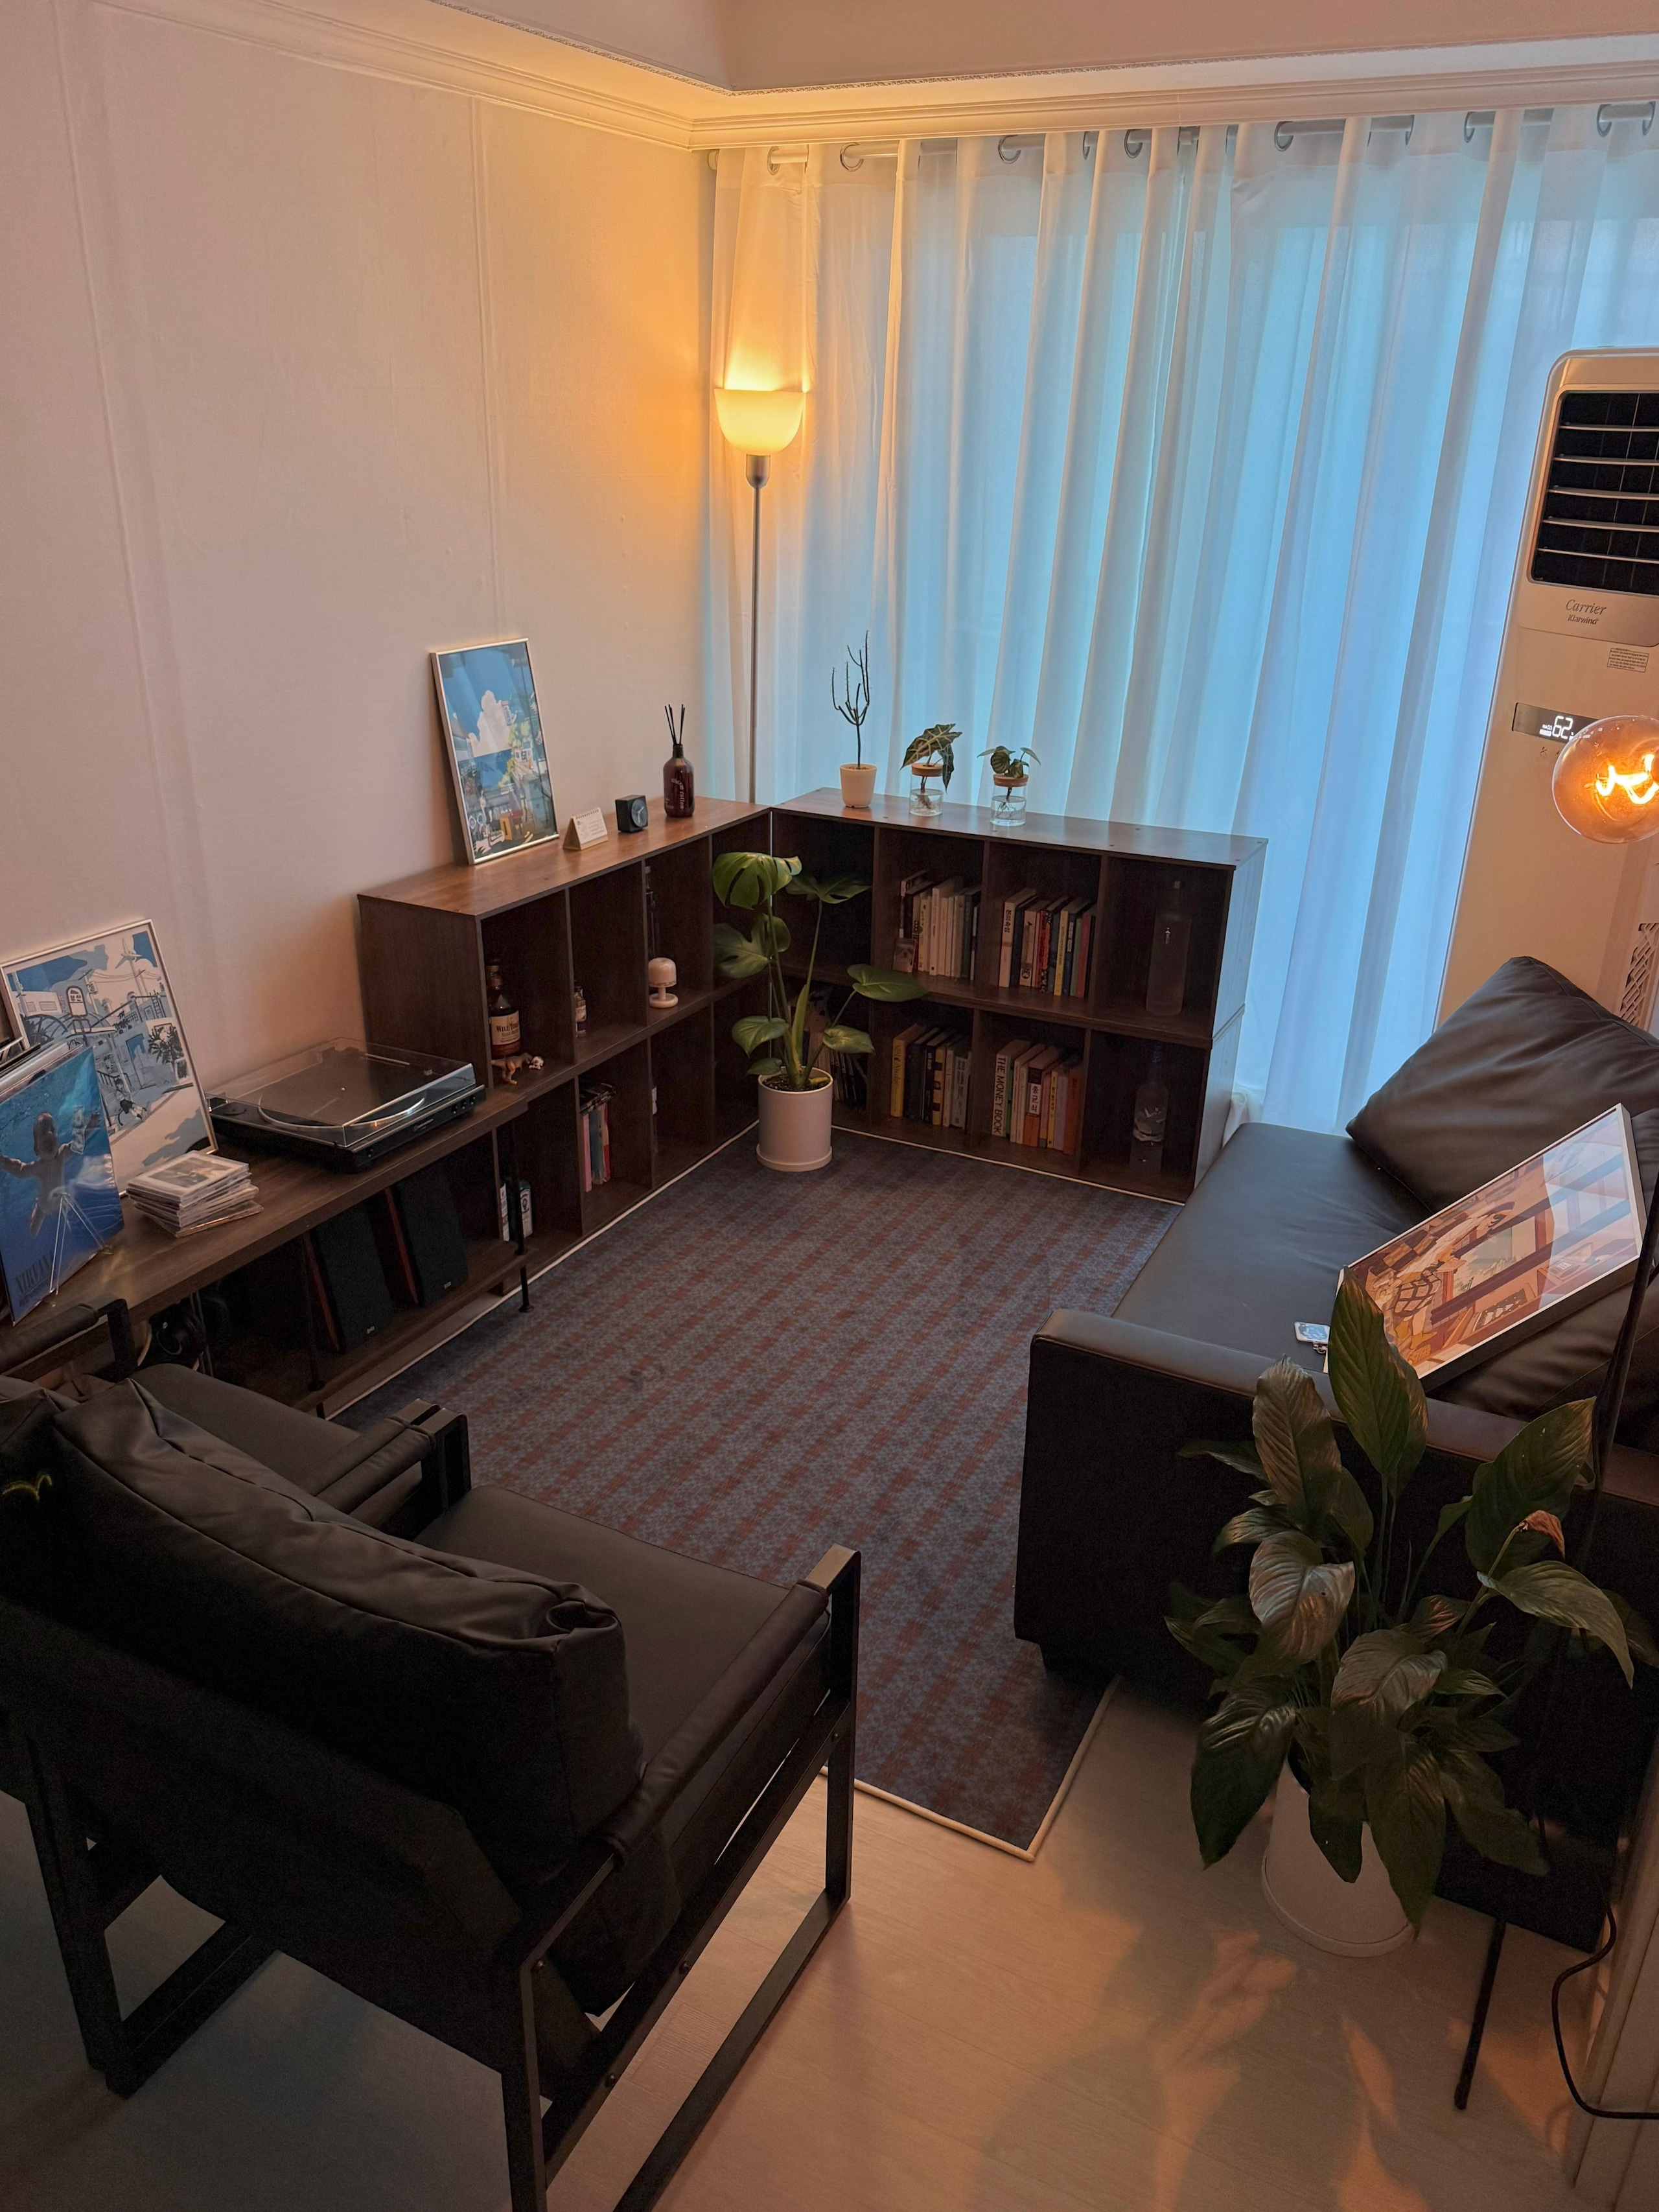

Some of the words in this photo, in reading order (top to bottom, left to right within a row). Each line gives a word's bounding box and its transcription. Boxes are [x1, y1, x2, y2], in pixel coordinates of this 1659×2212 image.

[1566, 599, 1607, 614] Carrier
[1552, 716, 1573, 739] 62
[997, 1057, 1006, 1074] THE
[995, 1076, 1004, 1108] MONEY
[993, 1109, 1003, 1135] BOOK
